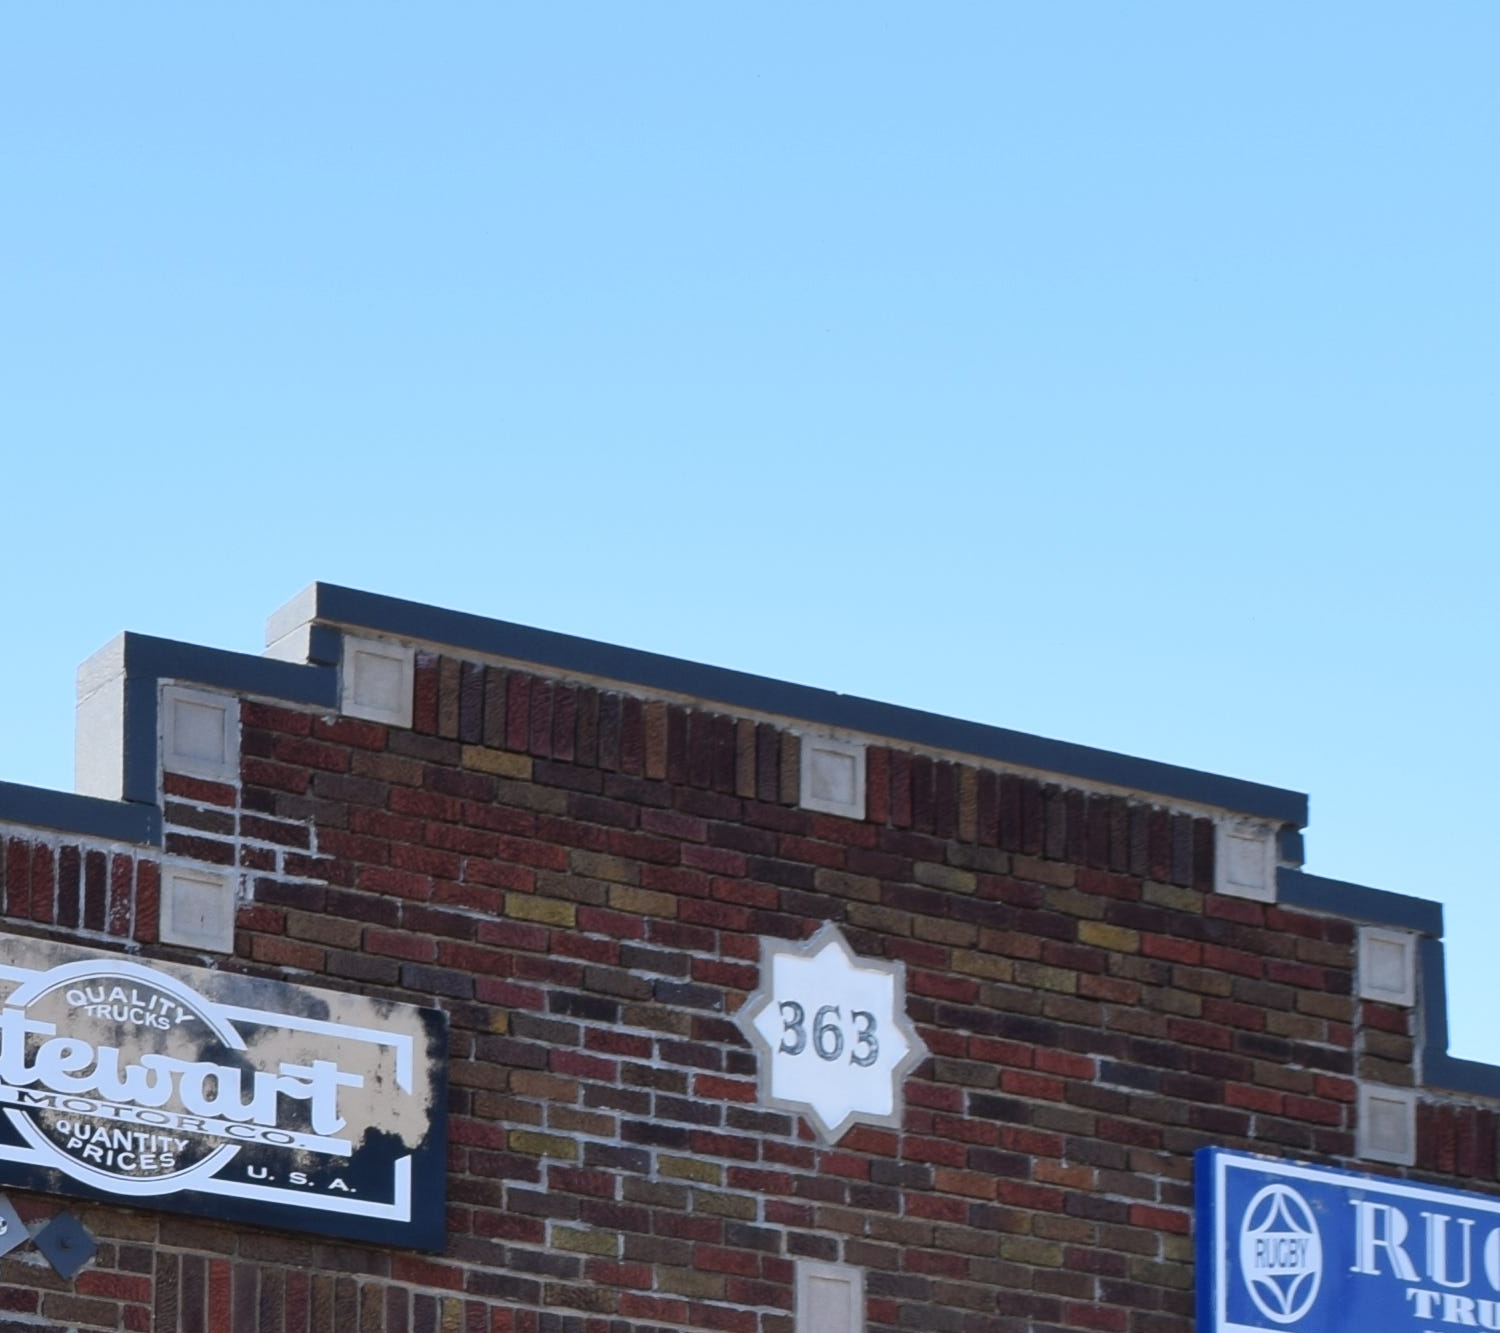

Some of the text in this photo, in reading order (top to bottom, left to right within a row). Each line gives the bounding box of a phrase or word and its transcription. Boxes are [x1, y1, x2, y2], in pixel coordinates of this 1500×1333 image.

[65, 985, 196, 1025] QUALITY
[84, 1003, 172, 1031] TRUCKS
[777, 1000, 880, 1068] 363
[15, 1089, 210, 1134] MOTOR
[55, 1117, 190, 1153] QUANTITY
[66, 1136, 177, 1171] PRICES
[1253, 1236, 1313, 1270] RUGBY
